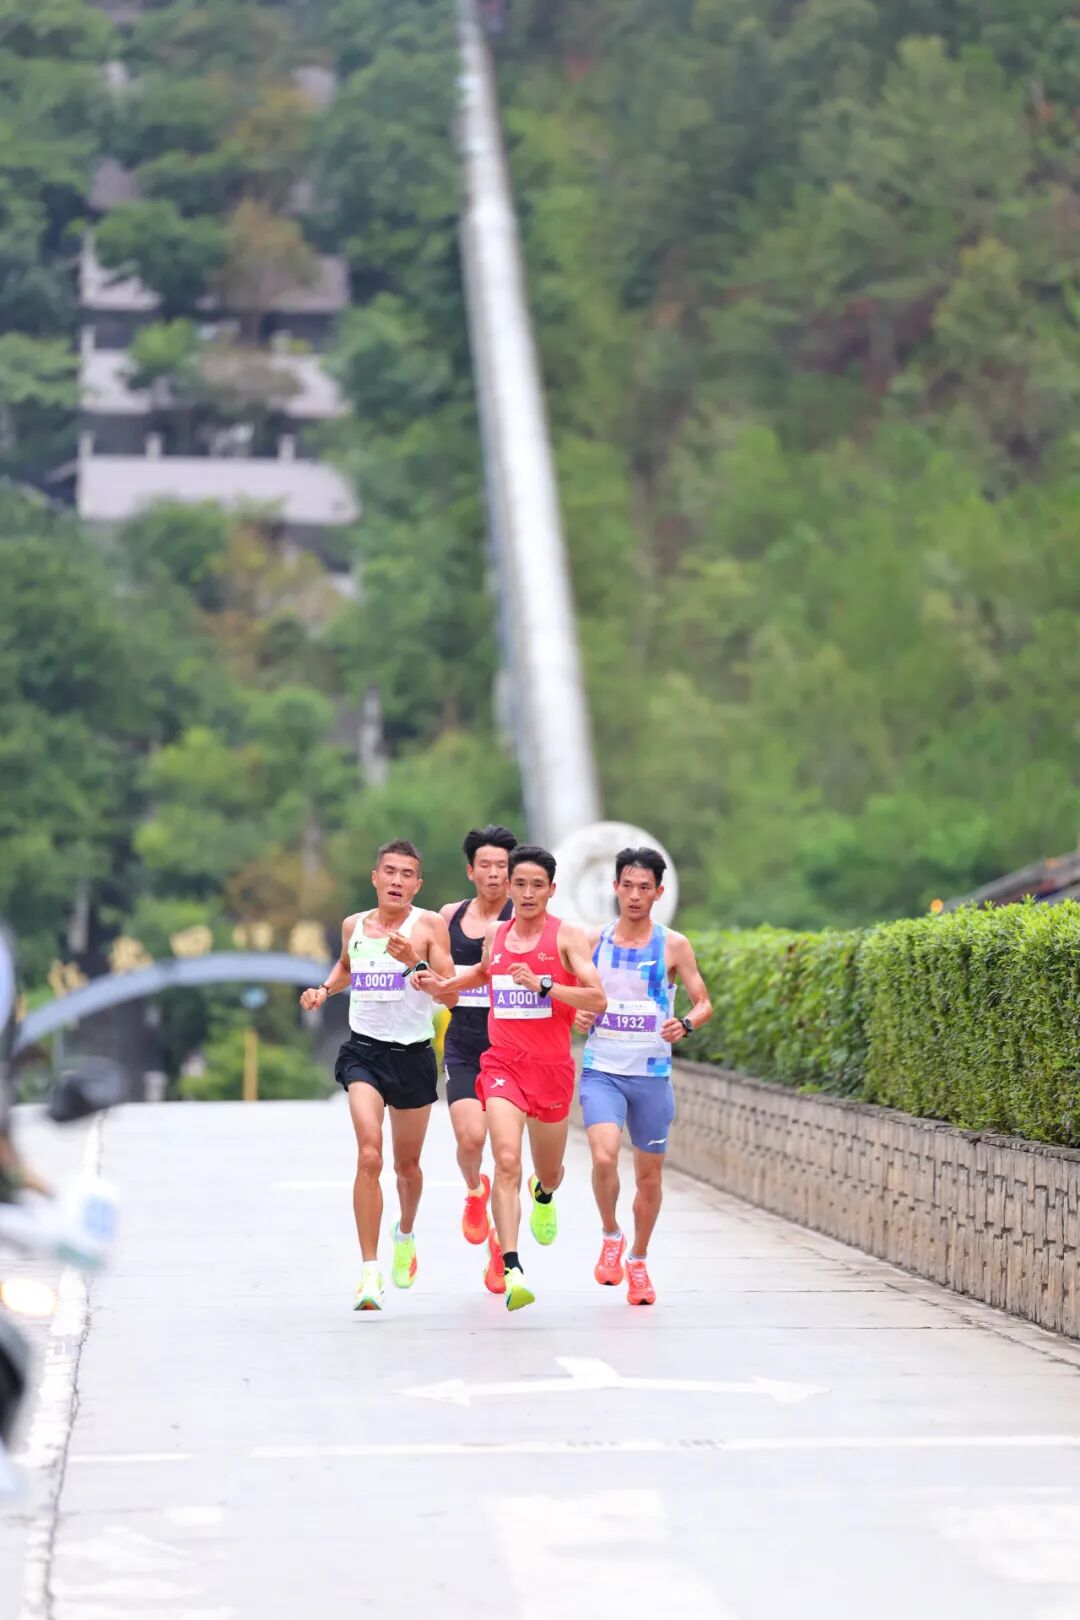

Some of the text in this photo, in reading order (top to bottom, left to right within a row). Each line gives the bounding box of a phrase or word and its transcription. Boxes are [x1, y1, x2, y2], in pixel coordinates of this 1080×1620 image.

[355, 974, 395, 987] A 0007
[497, 991, 538, 1005] A 0001
[601, 1014, 645, 1028] A 1932
